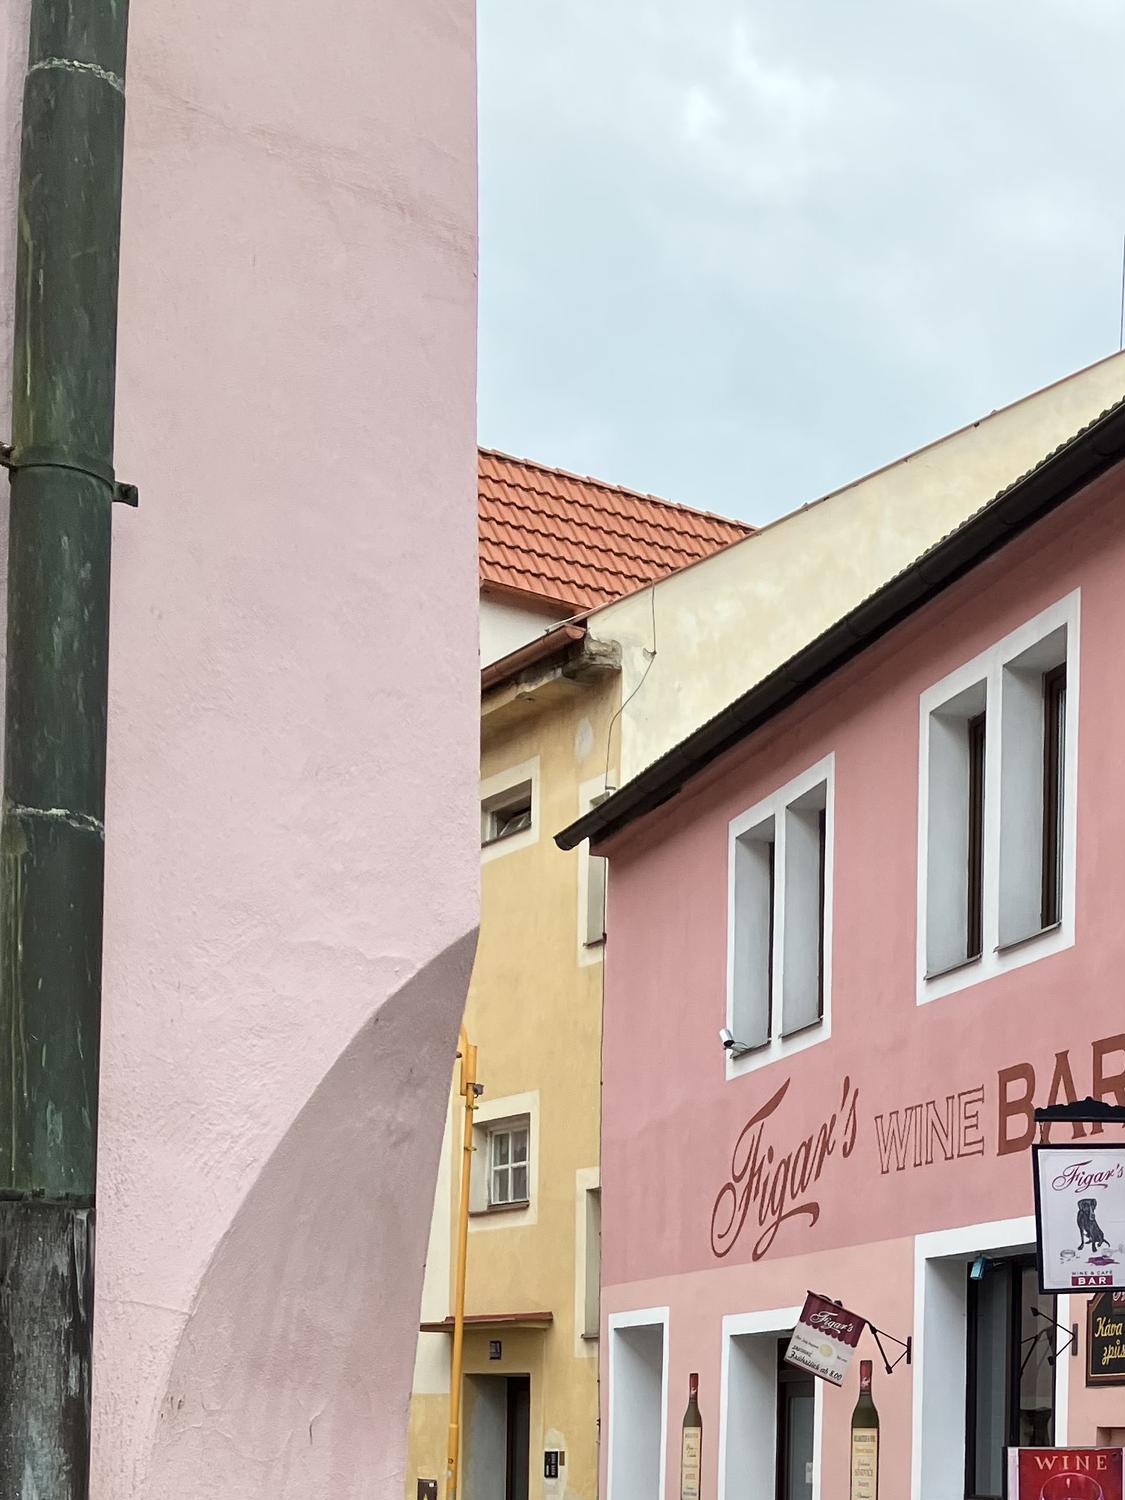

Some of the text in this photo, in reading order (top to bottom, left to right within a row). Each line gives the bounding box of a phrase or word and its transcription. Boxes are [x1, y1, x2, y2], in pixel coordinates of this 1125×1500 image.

[710, 1076, 859, 1261] Figar's
[874, 1084, 985, 1175] WINE
[1052, 1160, 1124, 1193] Figar's
[1078, 1276, 1107, 1285] BAR
[810, 1311, 854, 1334] Figar's
[1095, 1317, 1122, 1338] Káva
[1034, 1455, 1108, 1471] WINE
